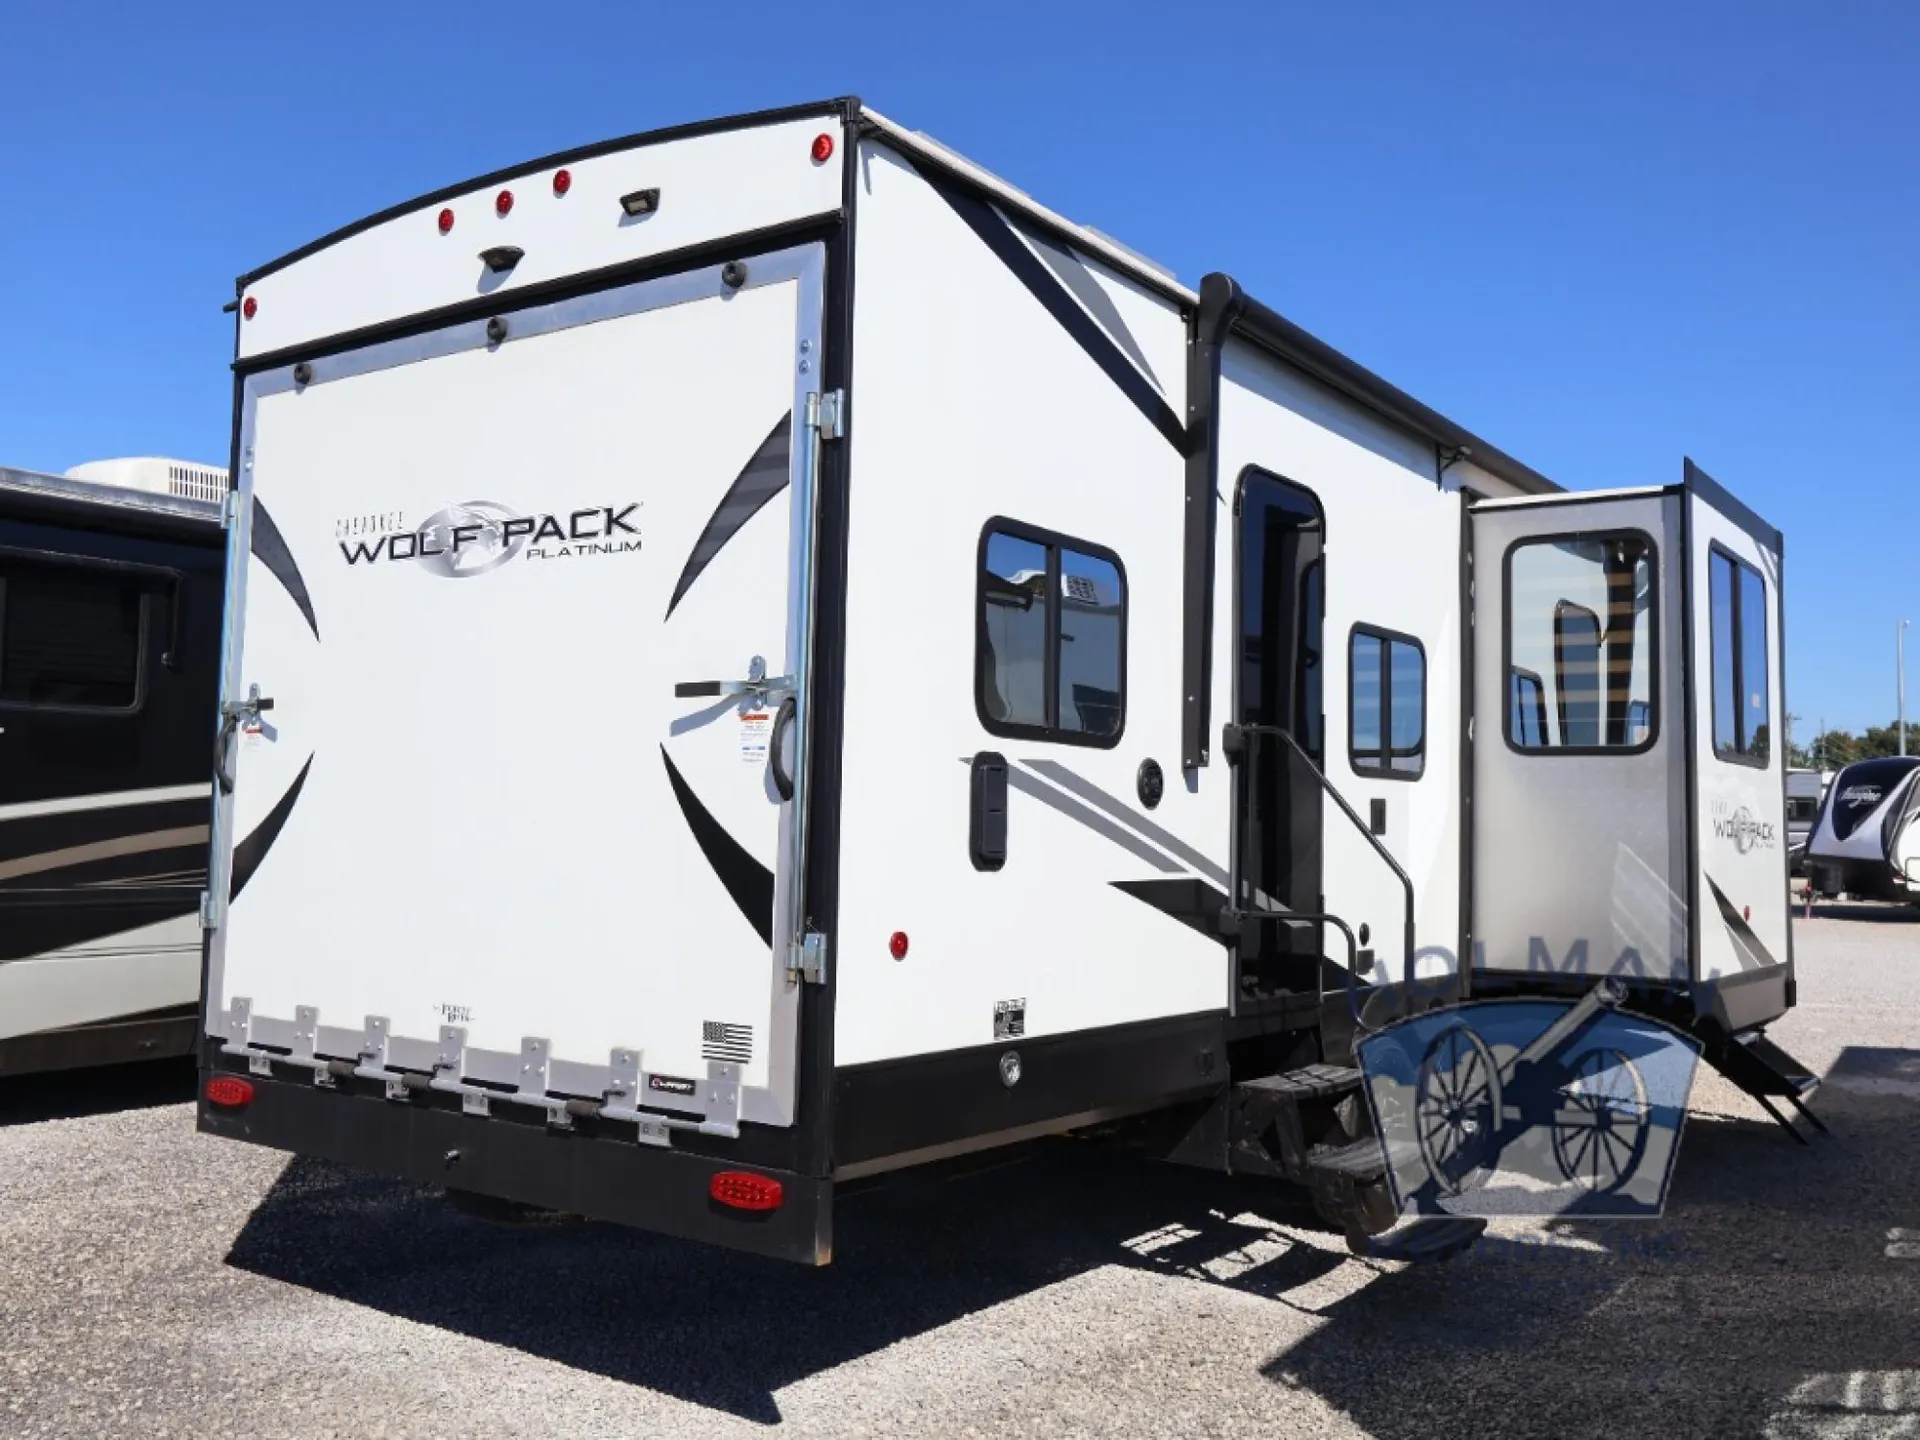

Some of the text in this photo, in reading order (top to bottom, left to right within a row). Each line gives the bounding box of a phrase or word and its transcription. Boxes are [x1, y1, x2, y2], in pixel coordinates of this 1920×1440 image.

[339, 501, 643, 566] WOLF PACK
[526, 540, 643, 560] PLATINUM
